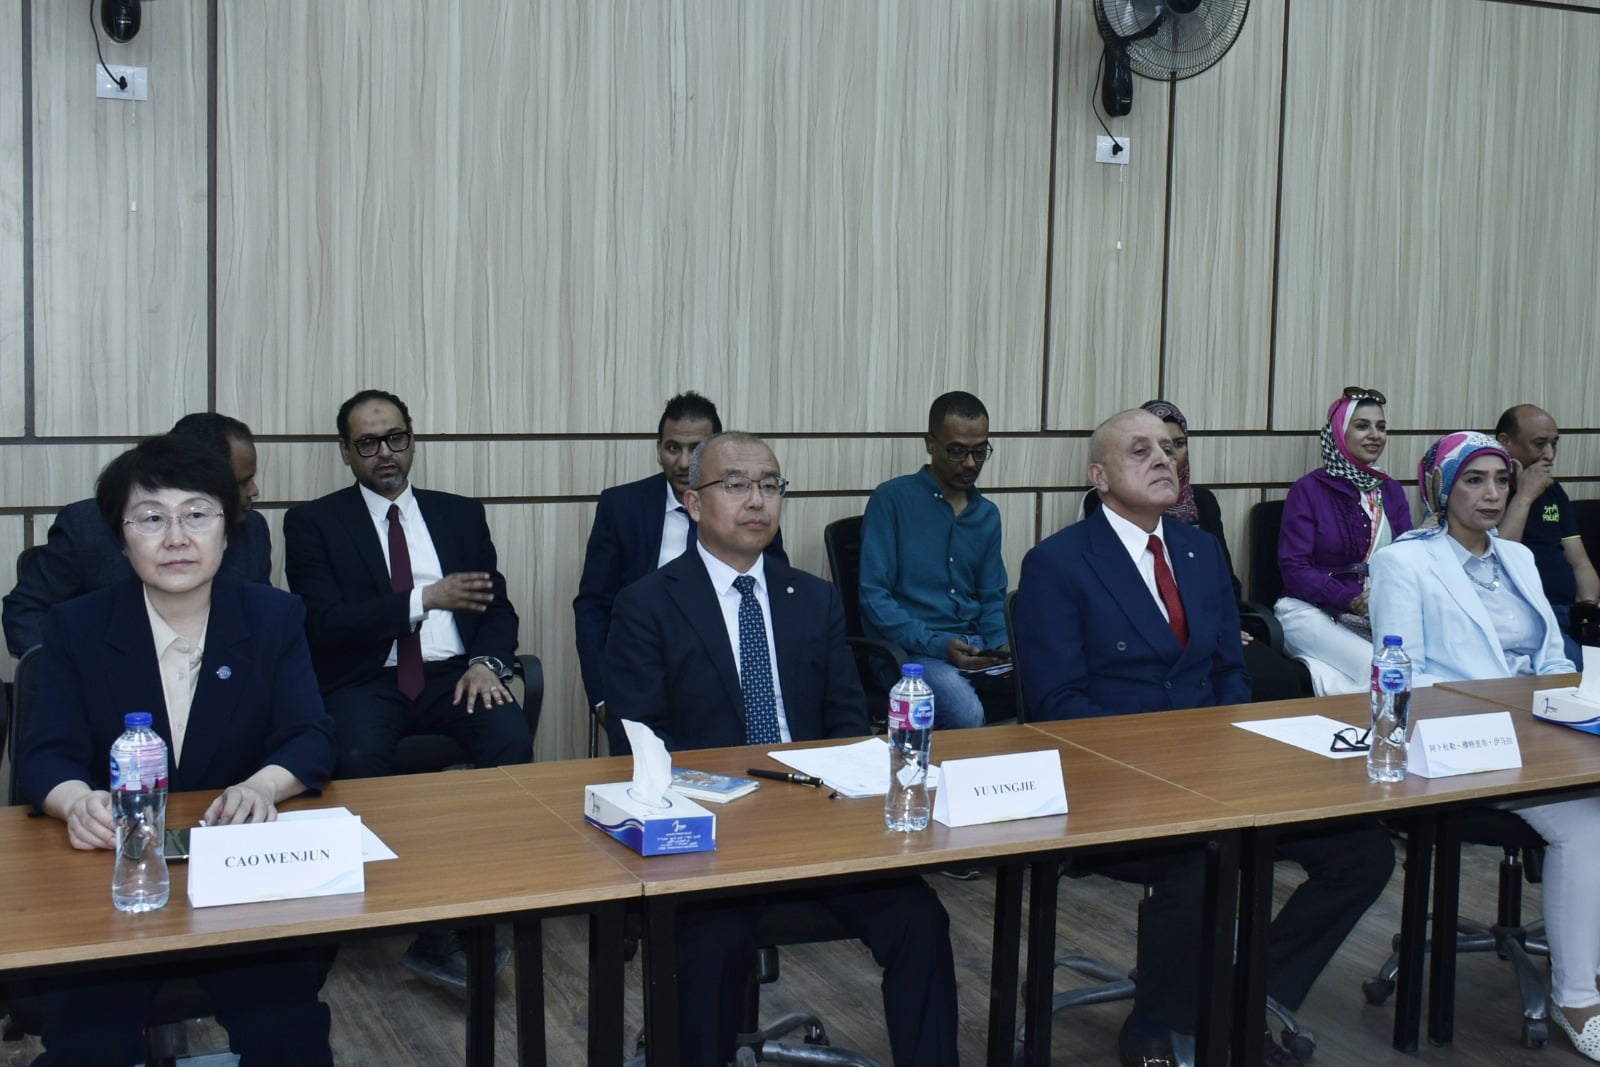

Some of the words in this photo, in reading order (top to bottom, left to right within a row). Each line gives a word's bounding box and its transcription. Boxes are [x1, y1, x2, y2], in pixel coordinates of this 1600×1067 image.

[973, 786, 988, 797] YU
[991, 780, 1037, 795] YINGJIE
[224, 853, 260, 868] CAO
[264, 848, 330, 864] WENJUN
